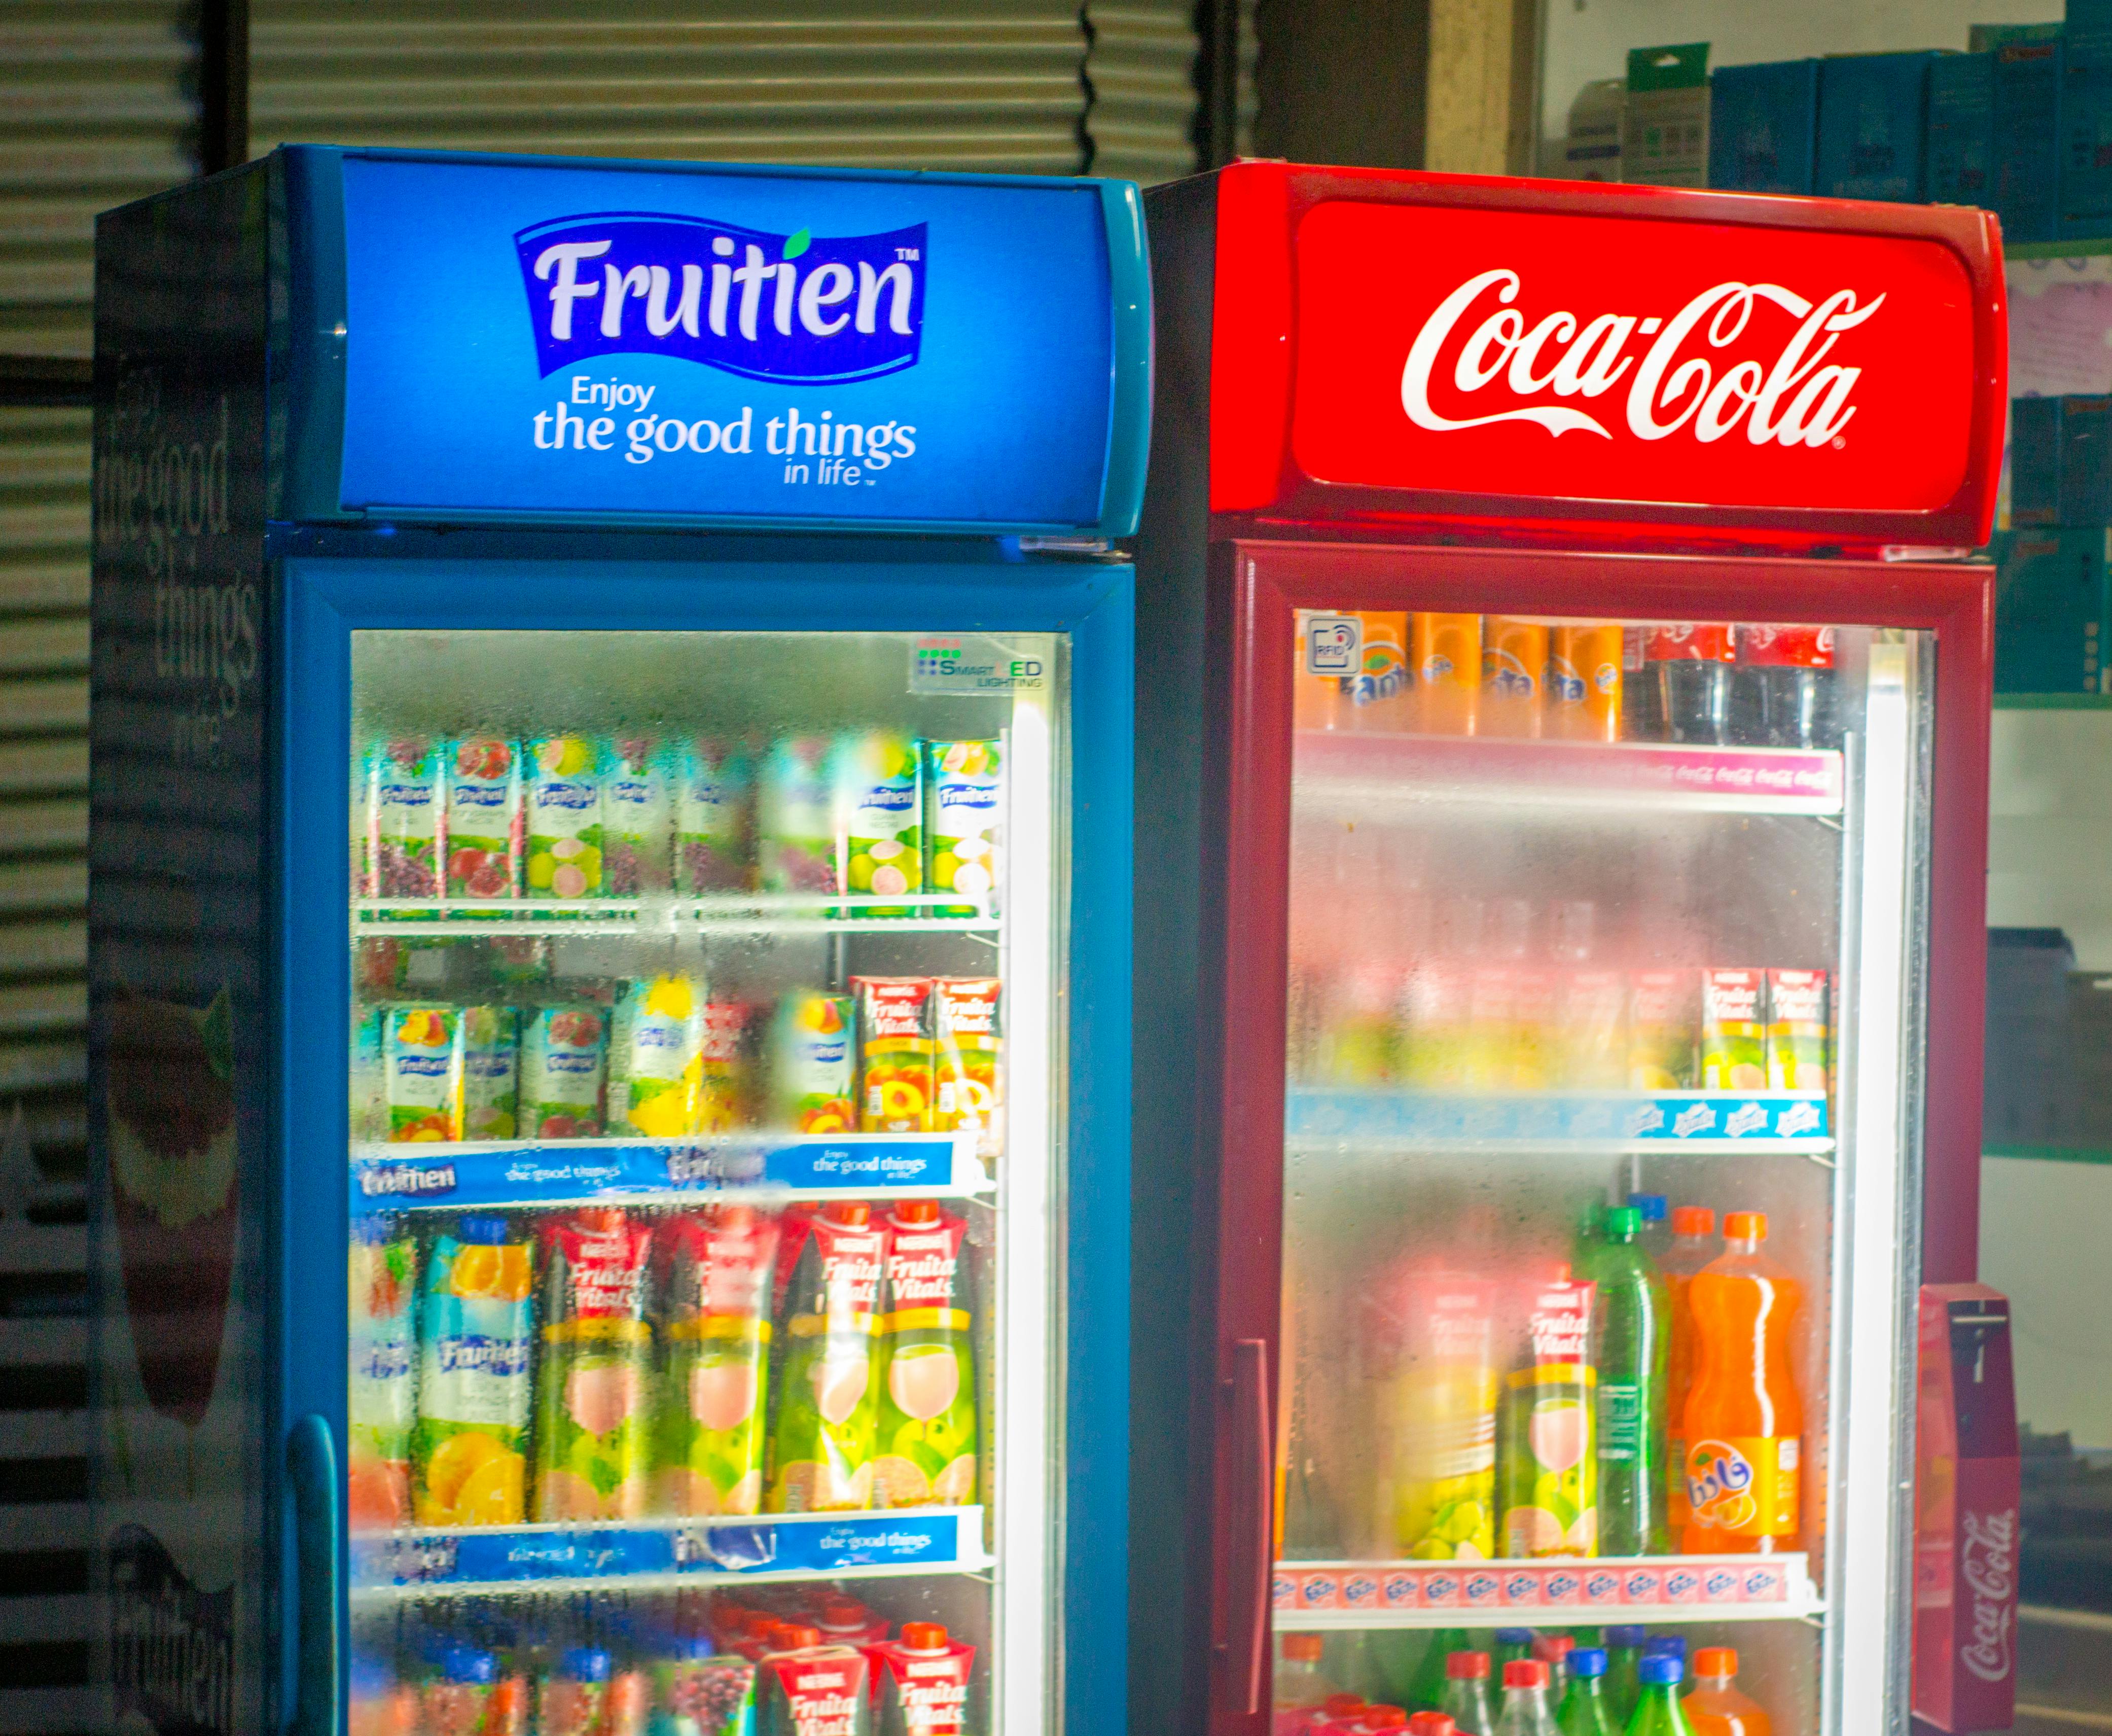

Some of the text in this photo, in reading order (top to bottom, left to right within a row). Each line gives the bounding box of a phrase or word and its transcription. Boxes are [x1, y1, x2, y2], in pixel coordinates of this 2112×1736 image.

[533, 231, 913, 341] Fruitien
[1401, 269, 1886, 447] Coca-Cola
[572, 376, 656, 412] Enjoy
[533, 402, 916, 470] the good things
[784, 458, 808, 484] in
[818, 458, 861, 485] life
[1316, 645, 1344, 656] RFID
[977, 678, 1043, 687] LIGHTING
[813, 1156, 927, 1175] the good things
[887, 1254, 958, 1280] Fruita
[891, 1278, 956, 1300] Vitals
[847, 1532, 886, 1550] good
[1961, 1507, 2015, 1682] Coca-Cola
[789, 1692, 858, 1719] Fruita
[898, 1681, 968, 1707] Fruita
